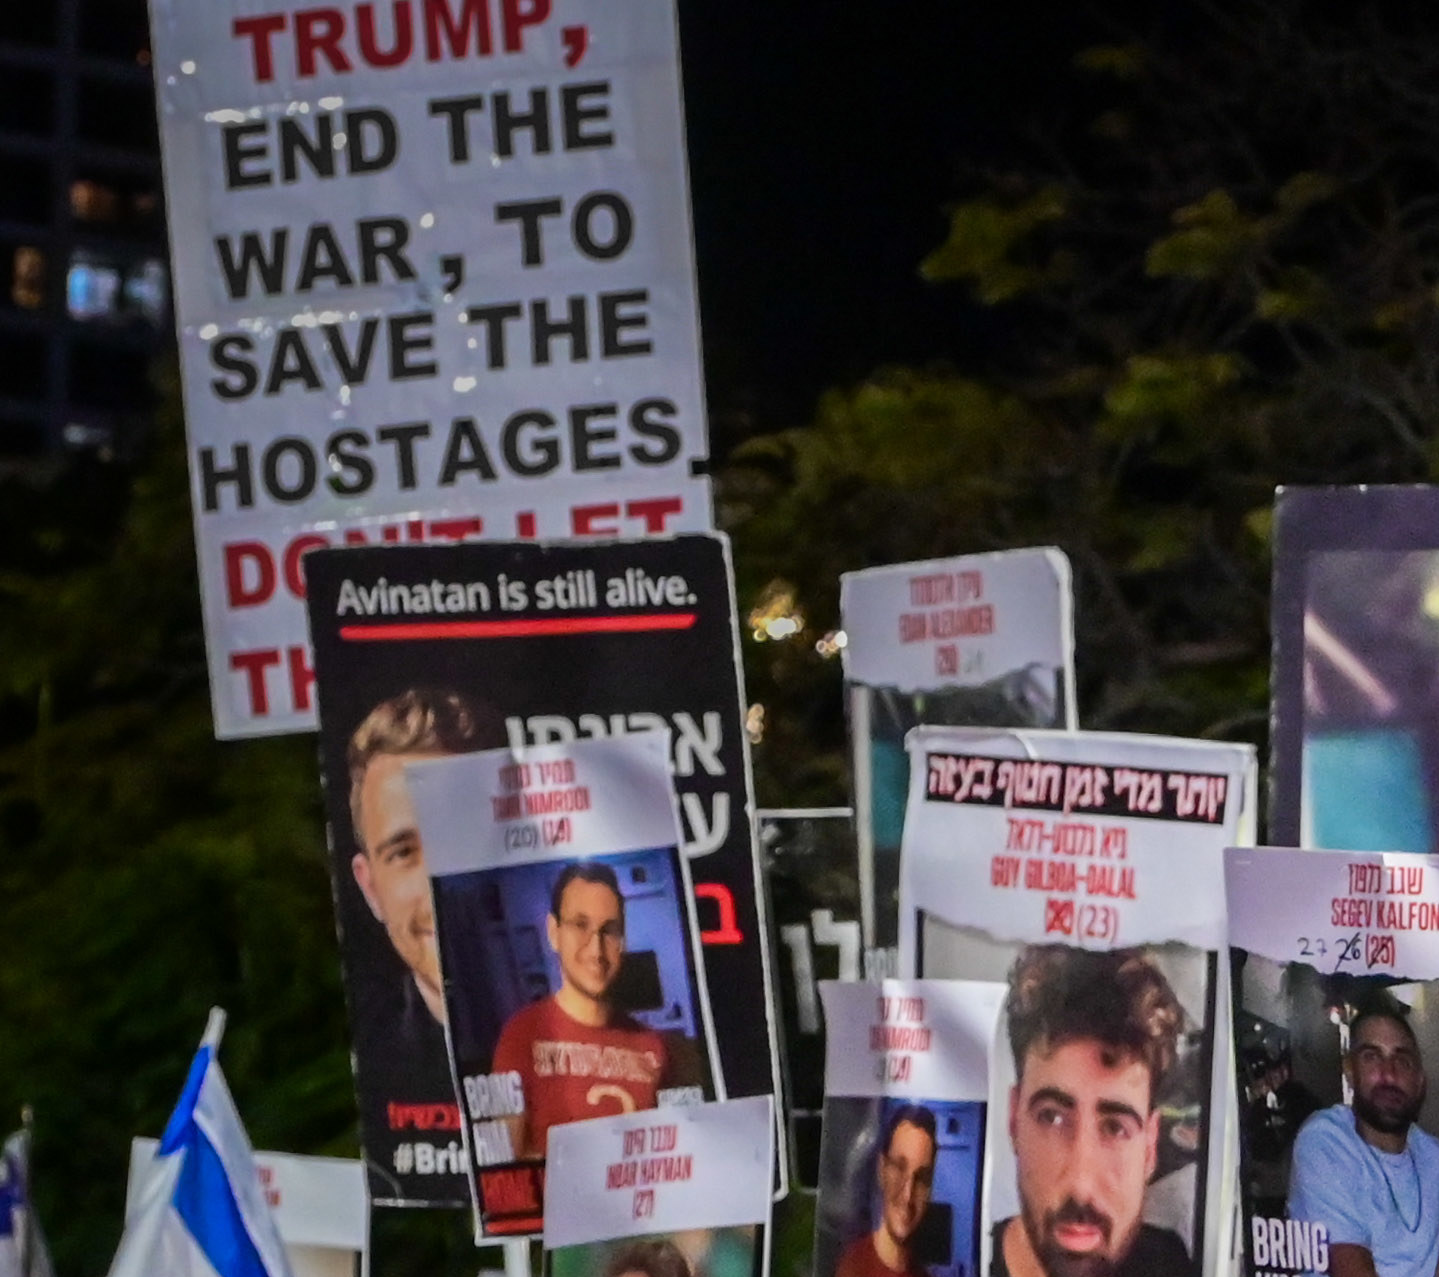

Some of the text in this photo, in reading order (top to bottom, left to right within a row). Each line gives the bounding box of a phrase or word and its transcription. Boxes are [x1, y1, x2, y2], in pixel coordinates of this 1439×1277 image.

[234, 0, 590, 83] TRUMP,
[221, 82, 614, 191] END THE
[496, 193, 633, 269] TO
[209, 290, 654, 404] SAVE THE
[336, 568, 697, 616] Avinatan is still alive.
[928, 754, 1226, 820] יותר מדי זמן חטוף בעזה
[1330, 898, 1374, 928] SEGEV
[1251, 1216, 1329, 1271] BRING
